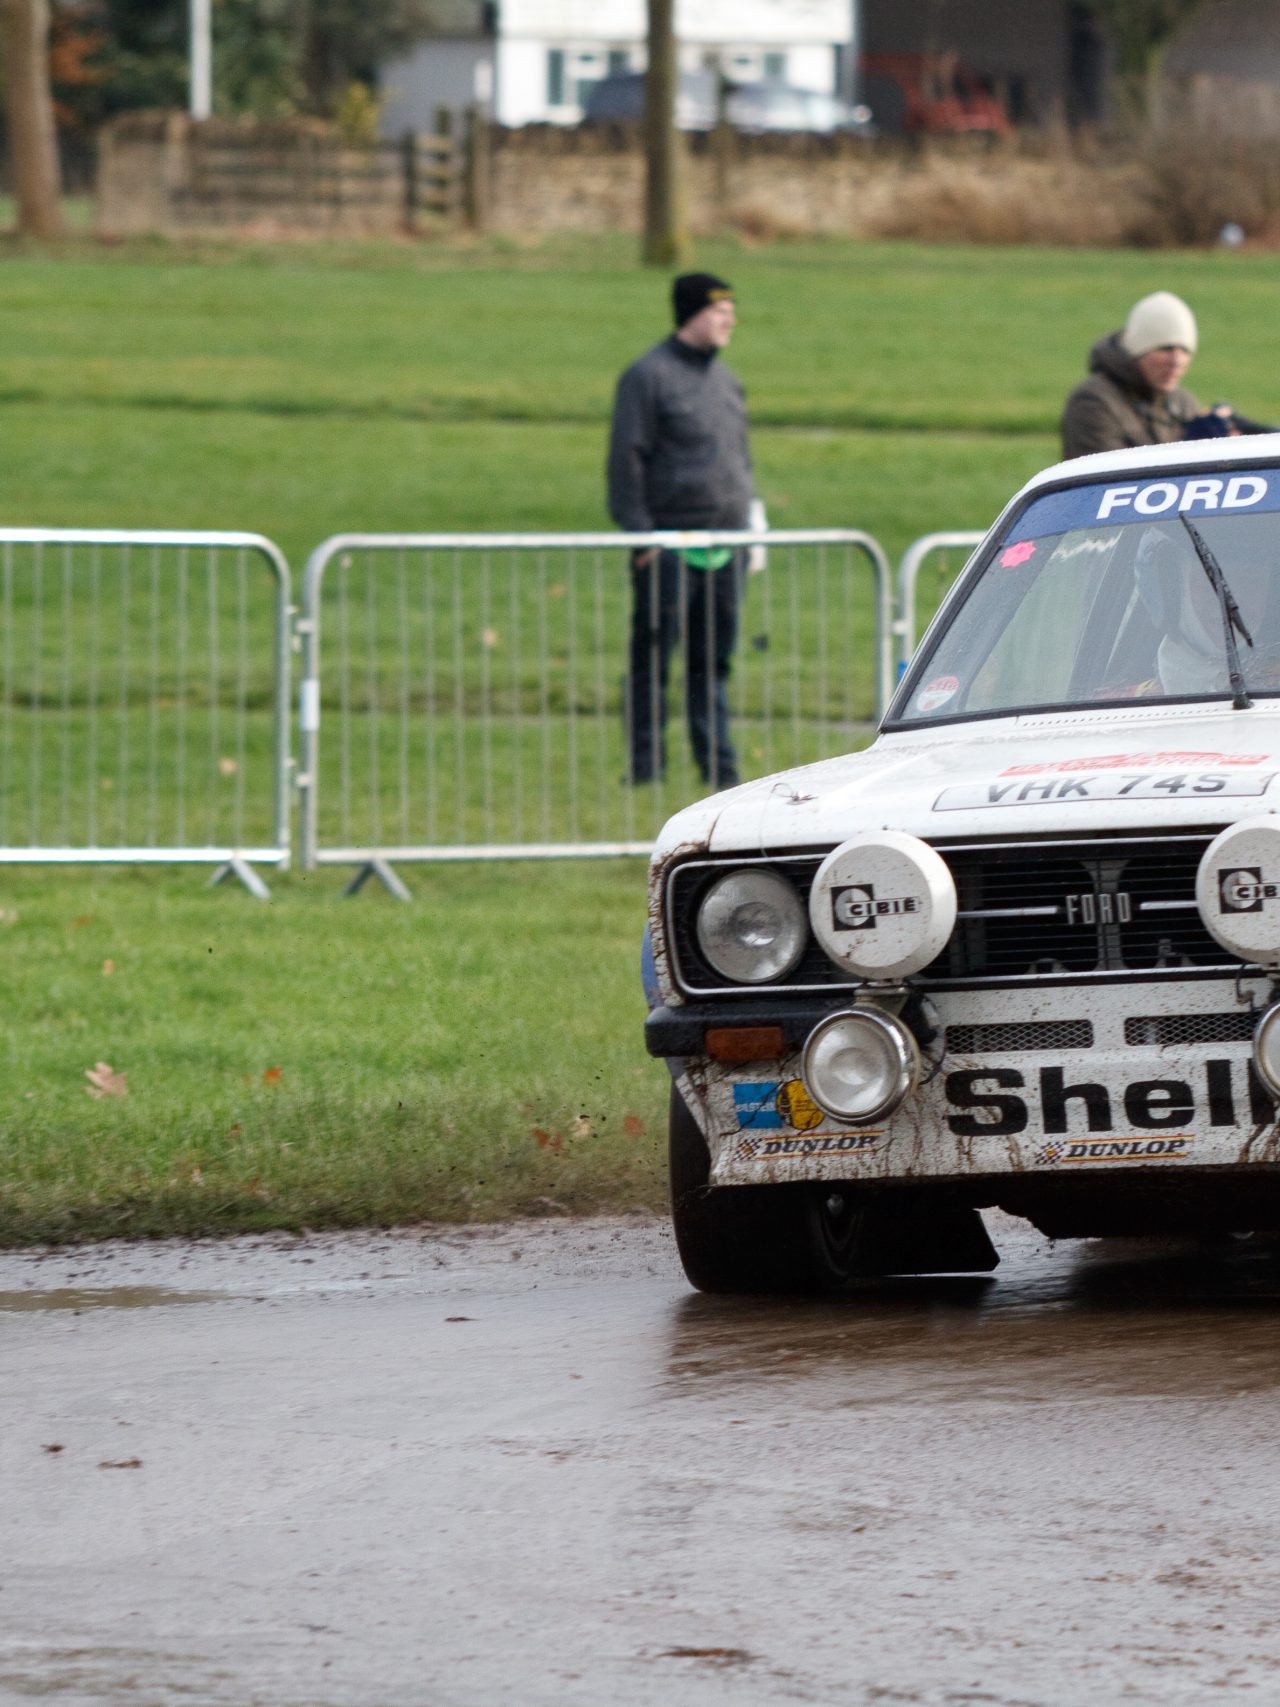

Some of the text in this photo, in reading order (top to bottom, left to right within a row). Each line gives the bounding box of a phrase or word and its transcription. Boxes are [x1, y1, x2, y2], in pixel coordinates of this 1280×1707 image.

[1097, 476, 1267, 519] FORD
[988, 773, 1230, 802] VHK 74S
[1065, 892, 1132, 925] FORD
[944, 1058, 1277, 1137] Shell
[760, 1134, 880, 1156] DUNLOP
[1064, 1138, 1188, 1160] DUNLOP
